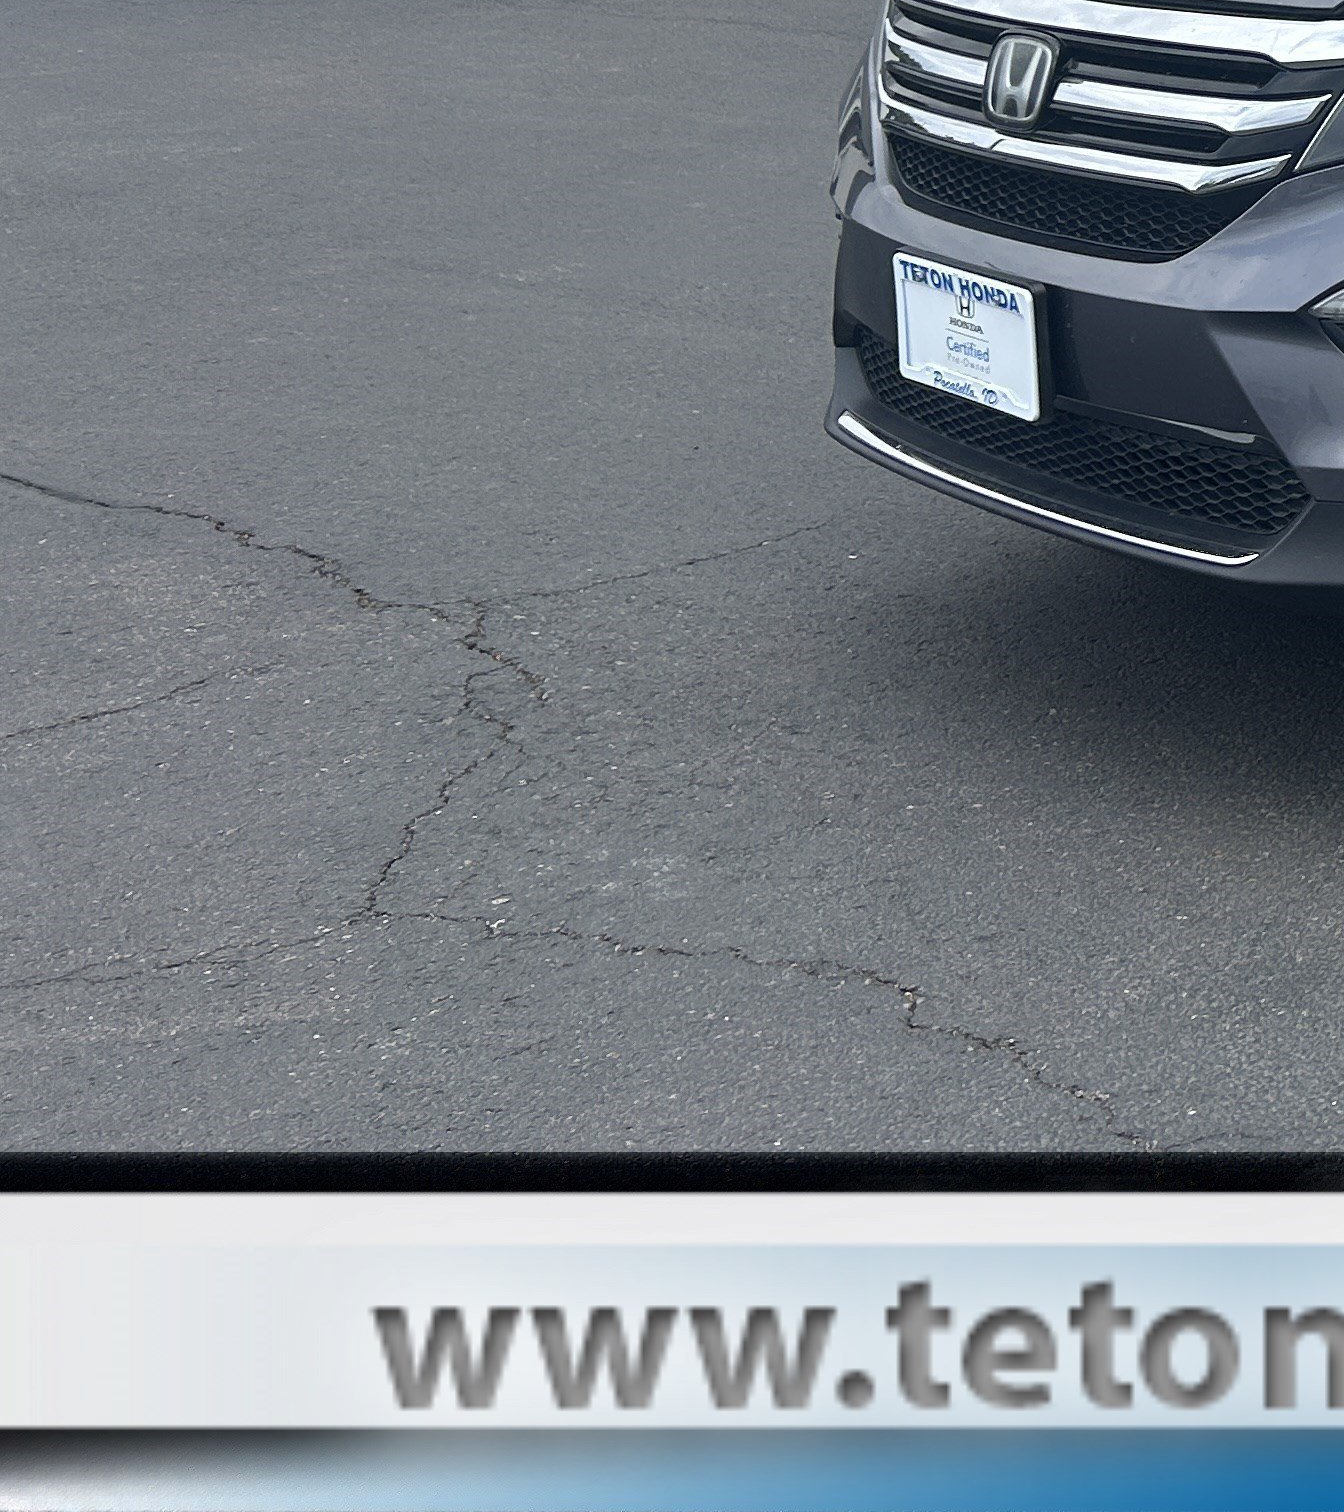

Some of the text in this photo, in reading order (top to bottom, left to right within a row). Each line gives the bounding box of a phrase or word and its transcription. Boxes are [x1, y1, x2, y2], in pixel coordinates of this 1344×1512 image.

[899, 259, 1020, 313] TETON HONDA
[949, 316, 985, 335] HONDA
[946, 336, 990, 363] Certified
